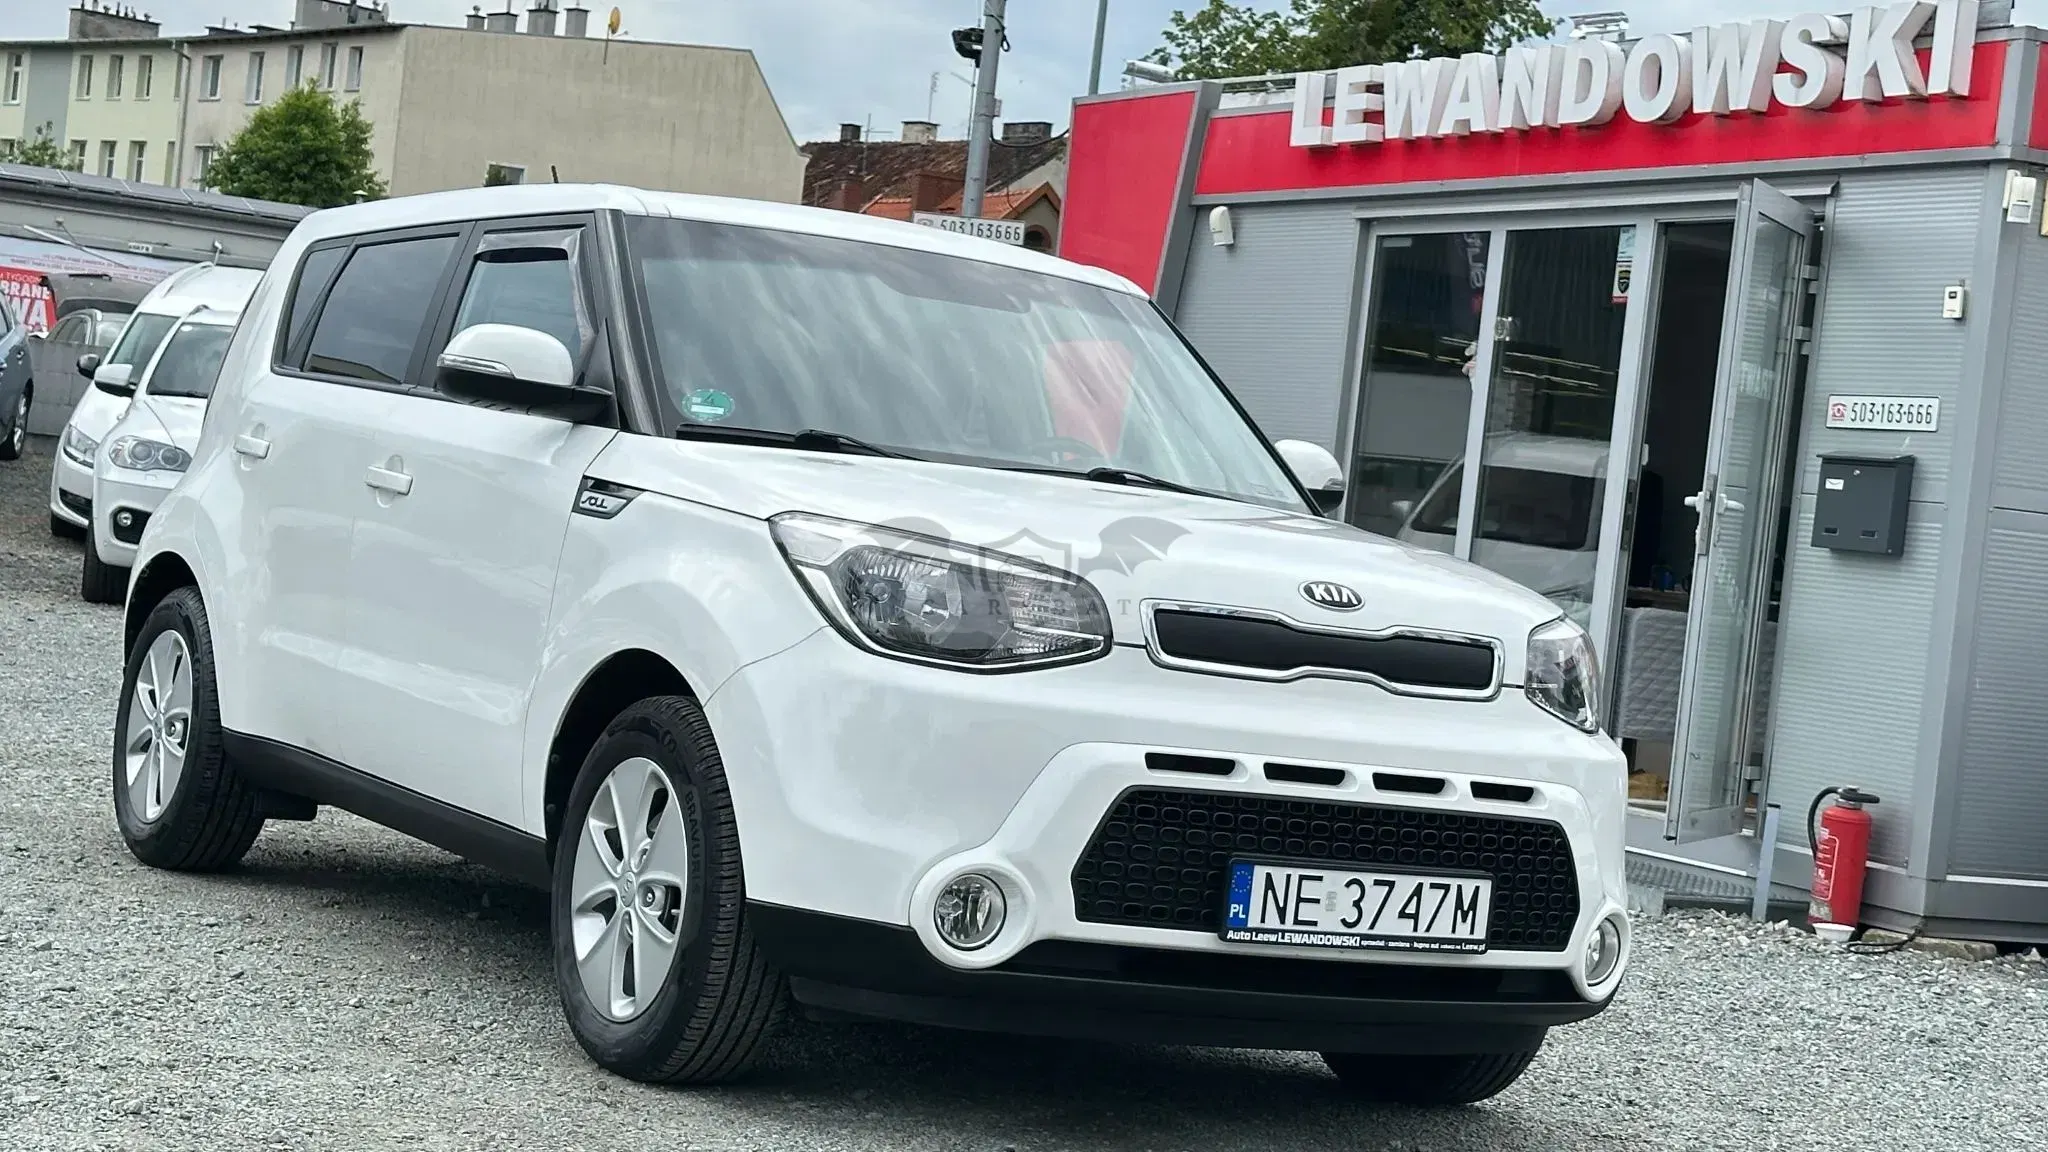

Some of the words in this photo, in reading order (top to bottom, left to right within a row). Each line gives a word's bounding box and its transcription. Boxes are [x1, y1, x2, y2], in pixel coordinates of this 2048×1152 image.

[1290, 0, 1978, 148] LEWANDOWSKI
[1308, 583, 1359, 605] KIA
[1229, 903, 1246, 919] PL
[1260, 871, 1324, 927] NE
[1340, 877, 1481, 935] 3747M
[1227, 930, 1251, 940] Auto
[1278, 932, 1360, 947] LEWANDOWSKI
